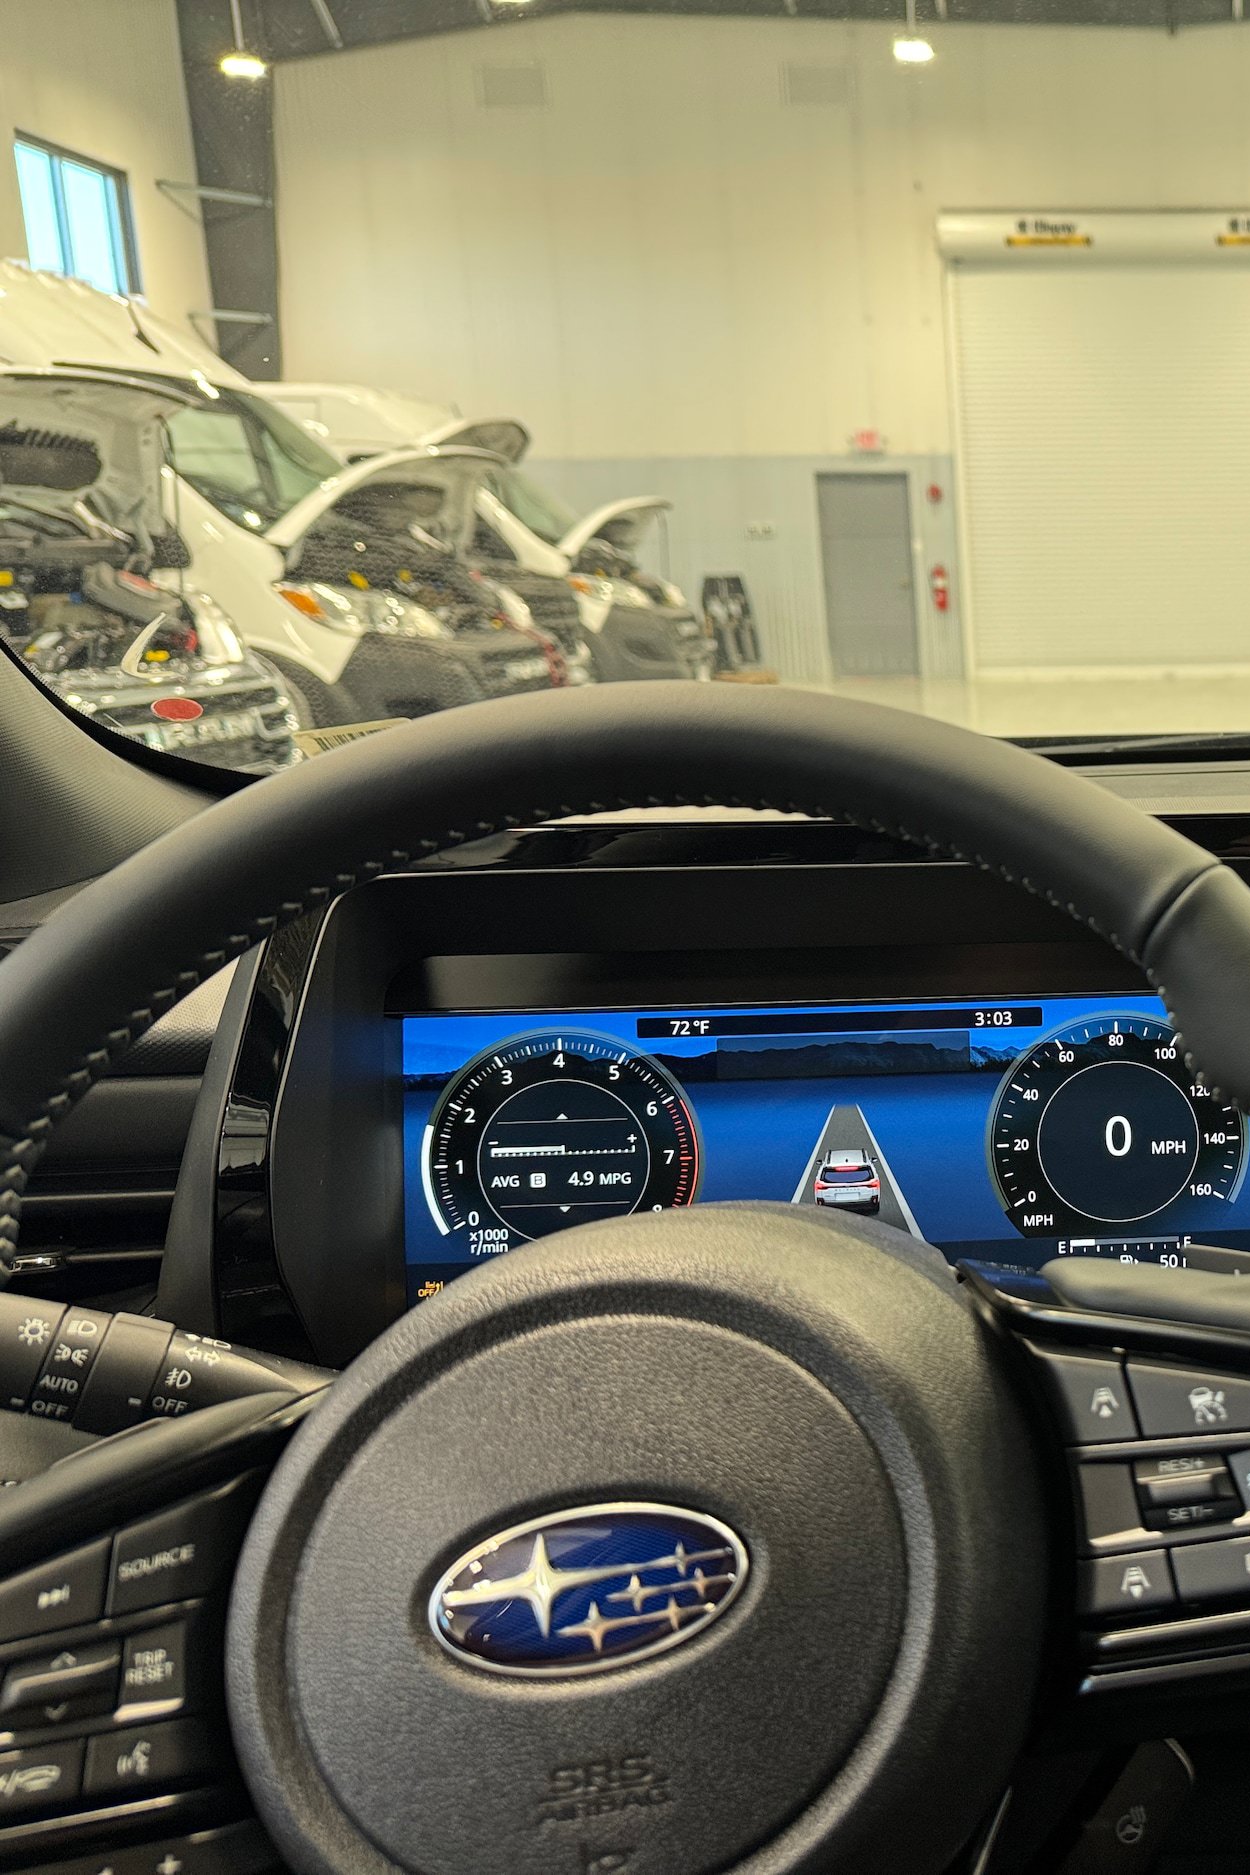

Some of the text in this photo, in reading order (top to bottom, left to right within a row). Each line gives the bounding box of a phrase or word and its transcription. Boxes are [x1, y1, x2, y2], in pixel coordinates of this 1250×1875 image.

[974, 1011, 1013, 1027] 3:03
[1108, 1034, 1124, 1047] 80
[553, 1053, 566, 1069] 4
[1058, 1051, 1075, 1064] 60
[1153, 1047, 1177, 1060] 100
[501, 1070, 514, 1085] 3
[608, 1065, 621, 1080] 5
[1022, 1089, 1039, 1102] 40
[463, 1108, 476, 1124] 2
[646, 1101, 659, 1117] 6
[1105, 1115, 1187, 1157] 0 MPH
[1203, 1131, 1226, 1145] 140
[1013, 1138, 1029, 1151] 20
[663, 1150, 676, 1165] 7
[455, 1159, 464, 1175] 1
[490, 1175, 520, 1189] AVG
[567, 1170, 595, 1187] 4.9
[599, 1171, 632, 1186] MPG
[1027, 1190, 1037, 1203] 0
[1189, 1183, 1212, 1197] 160
[467, 1211, 480, 1227] 0
[1023, 1213, 1054, 1227] MPH
[469, 1229, 509, 1242] x1000
[1183, 1235, 1192, 1248] F
[470, 1241, 509, 1256] r/min
[1057, 1241, 1067, 1254] E
[1159, 1254, 1179, 1268] 50
[38, 1374, 79, 1394] AUTO
[31, 1400, 69, 1418] OFF
[152, 1396, 190, 1413] OFF
[118, 1543, 196, 1582] SOURCE
[133, 1648, 168, 1667] TRIP
[124, 1662, 175, 1686] RESET
